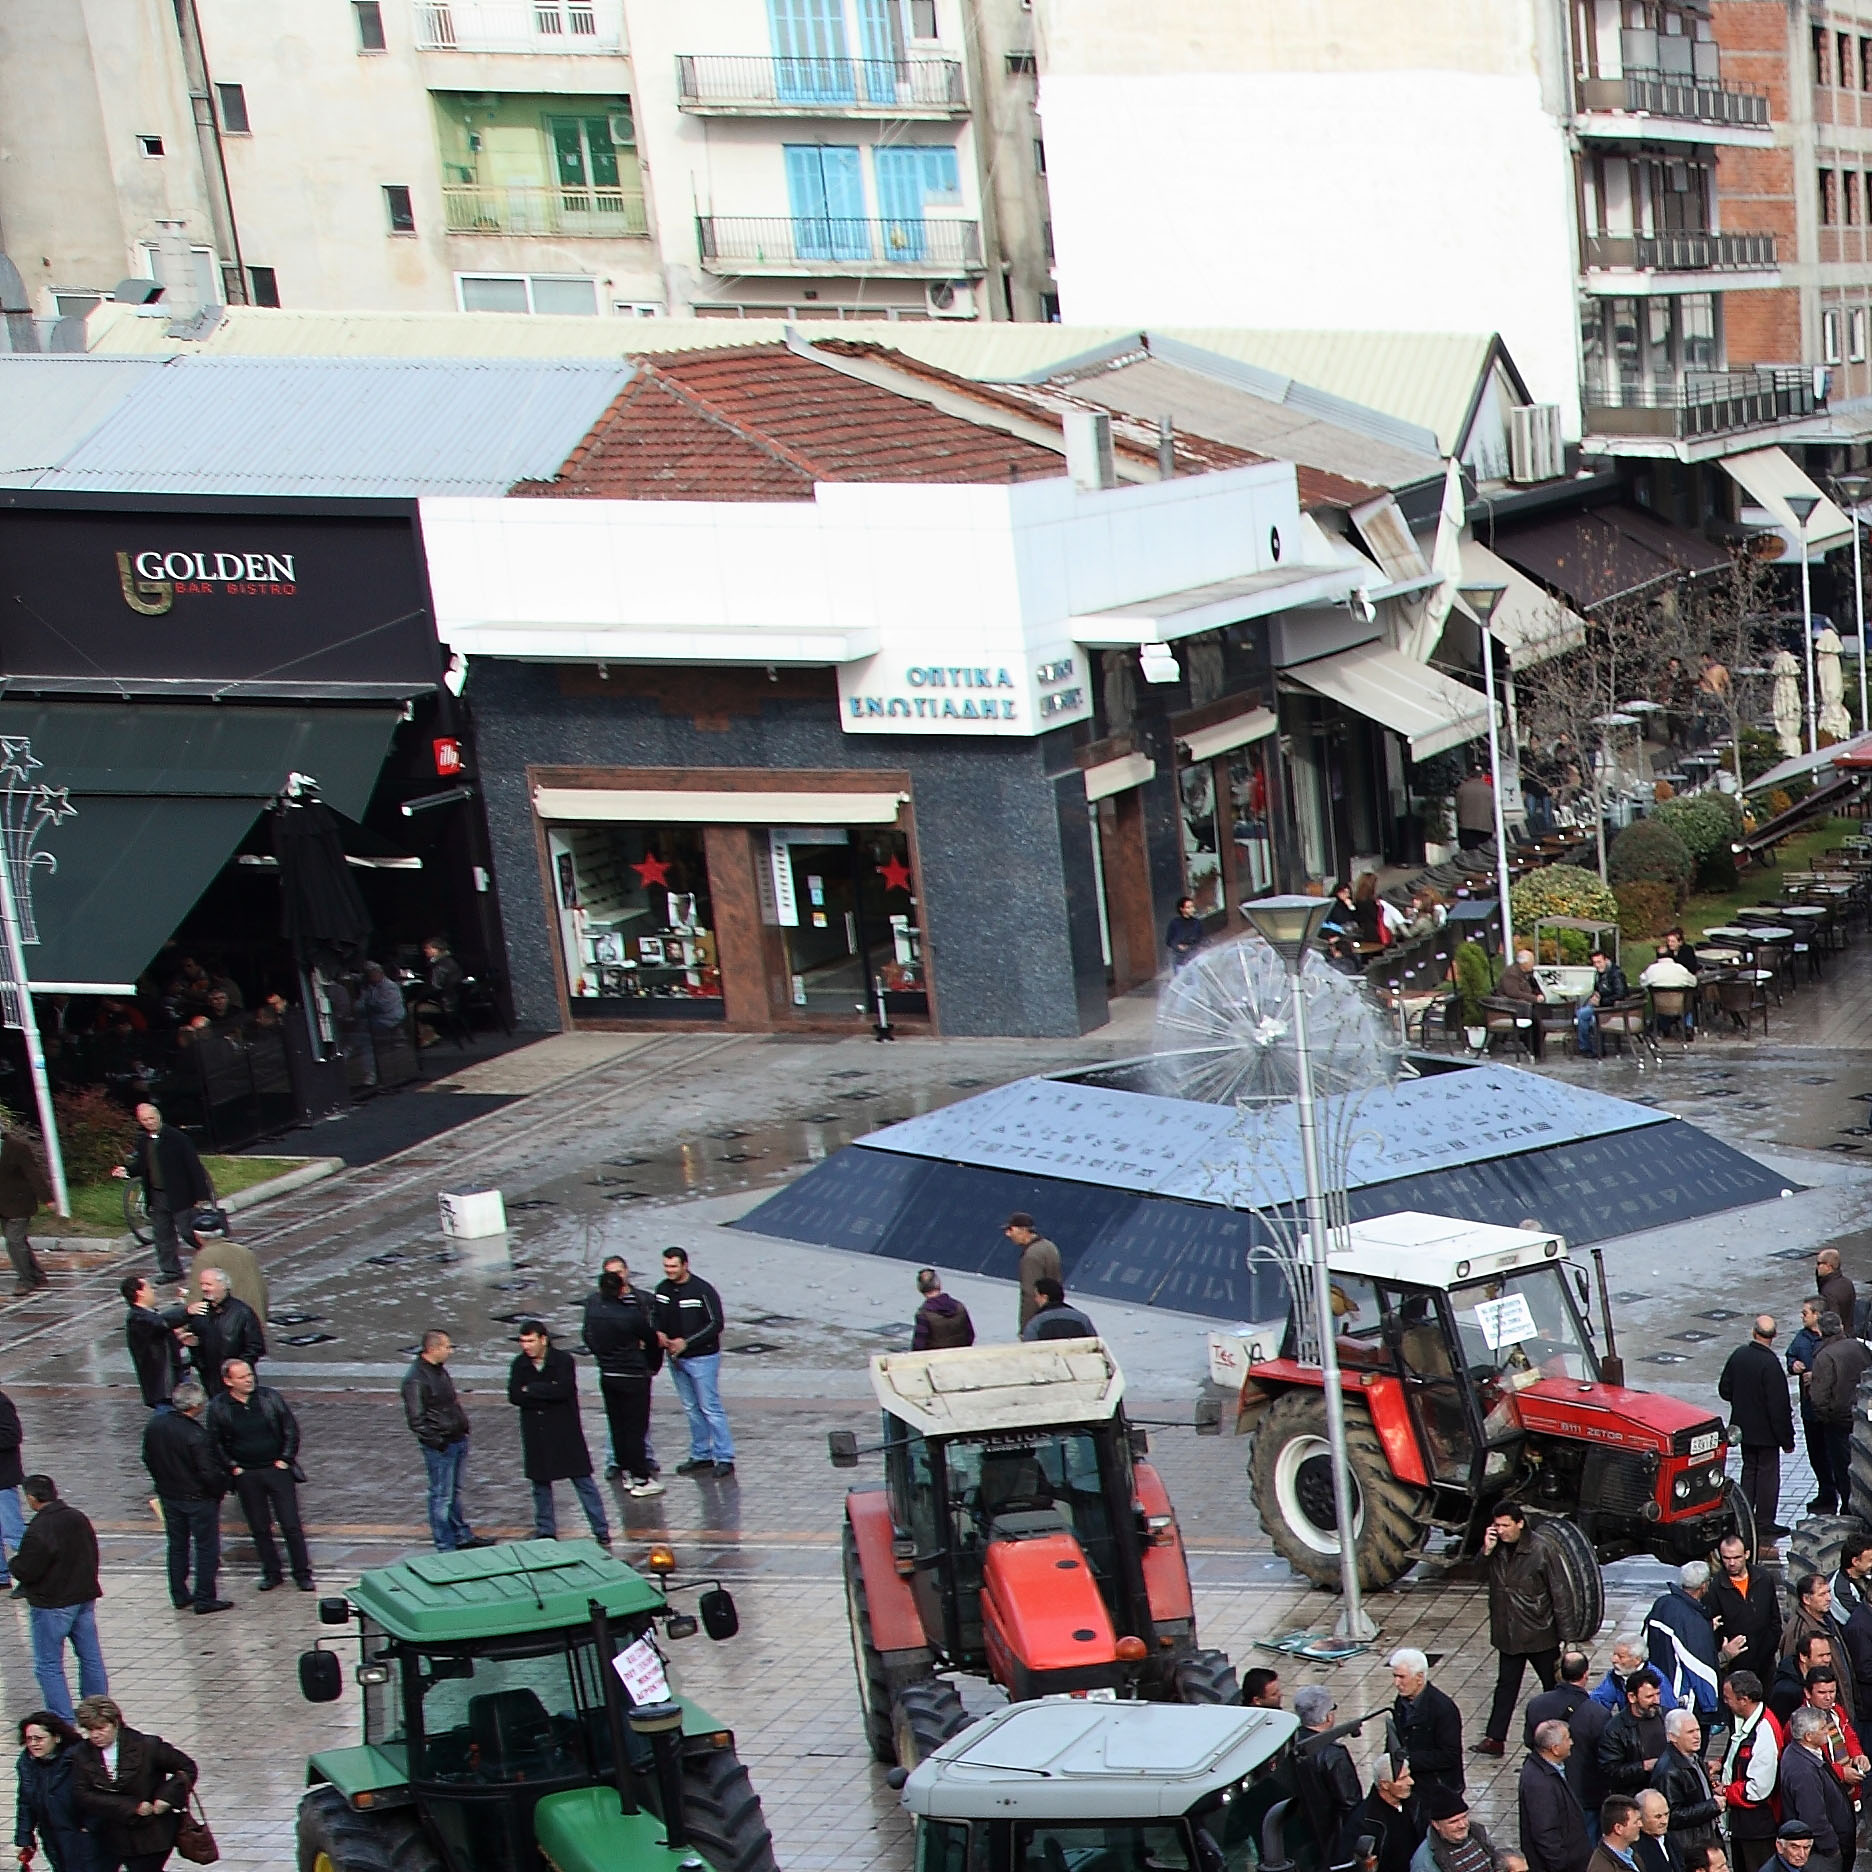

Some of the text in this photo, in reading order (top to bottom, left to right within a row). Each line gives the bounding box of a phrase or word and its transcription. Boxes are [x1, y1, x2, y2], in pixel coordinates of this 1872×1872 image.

[136, 551, 297, 582] GOLDEN
[175, 582, 297, 596] BAR BISTRO
[906, 666, 1015, 688] ΟΠΤΙΚΑ
[850, 696, 1018, 719] ΕΝΩΤΙΑΔΗΣ
